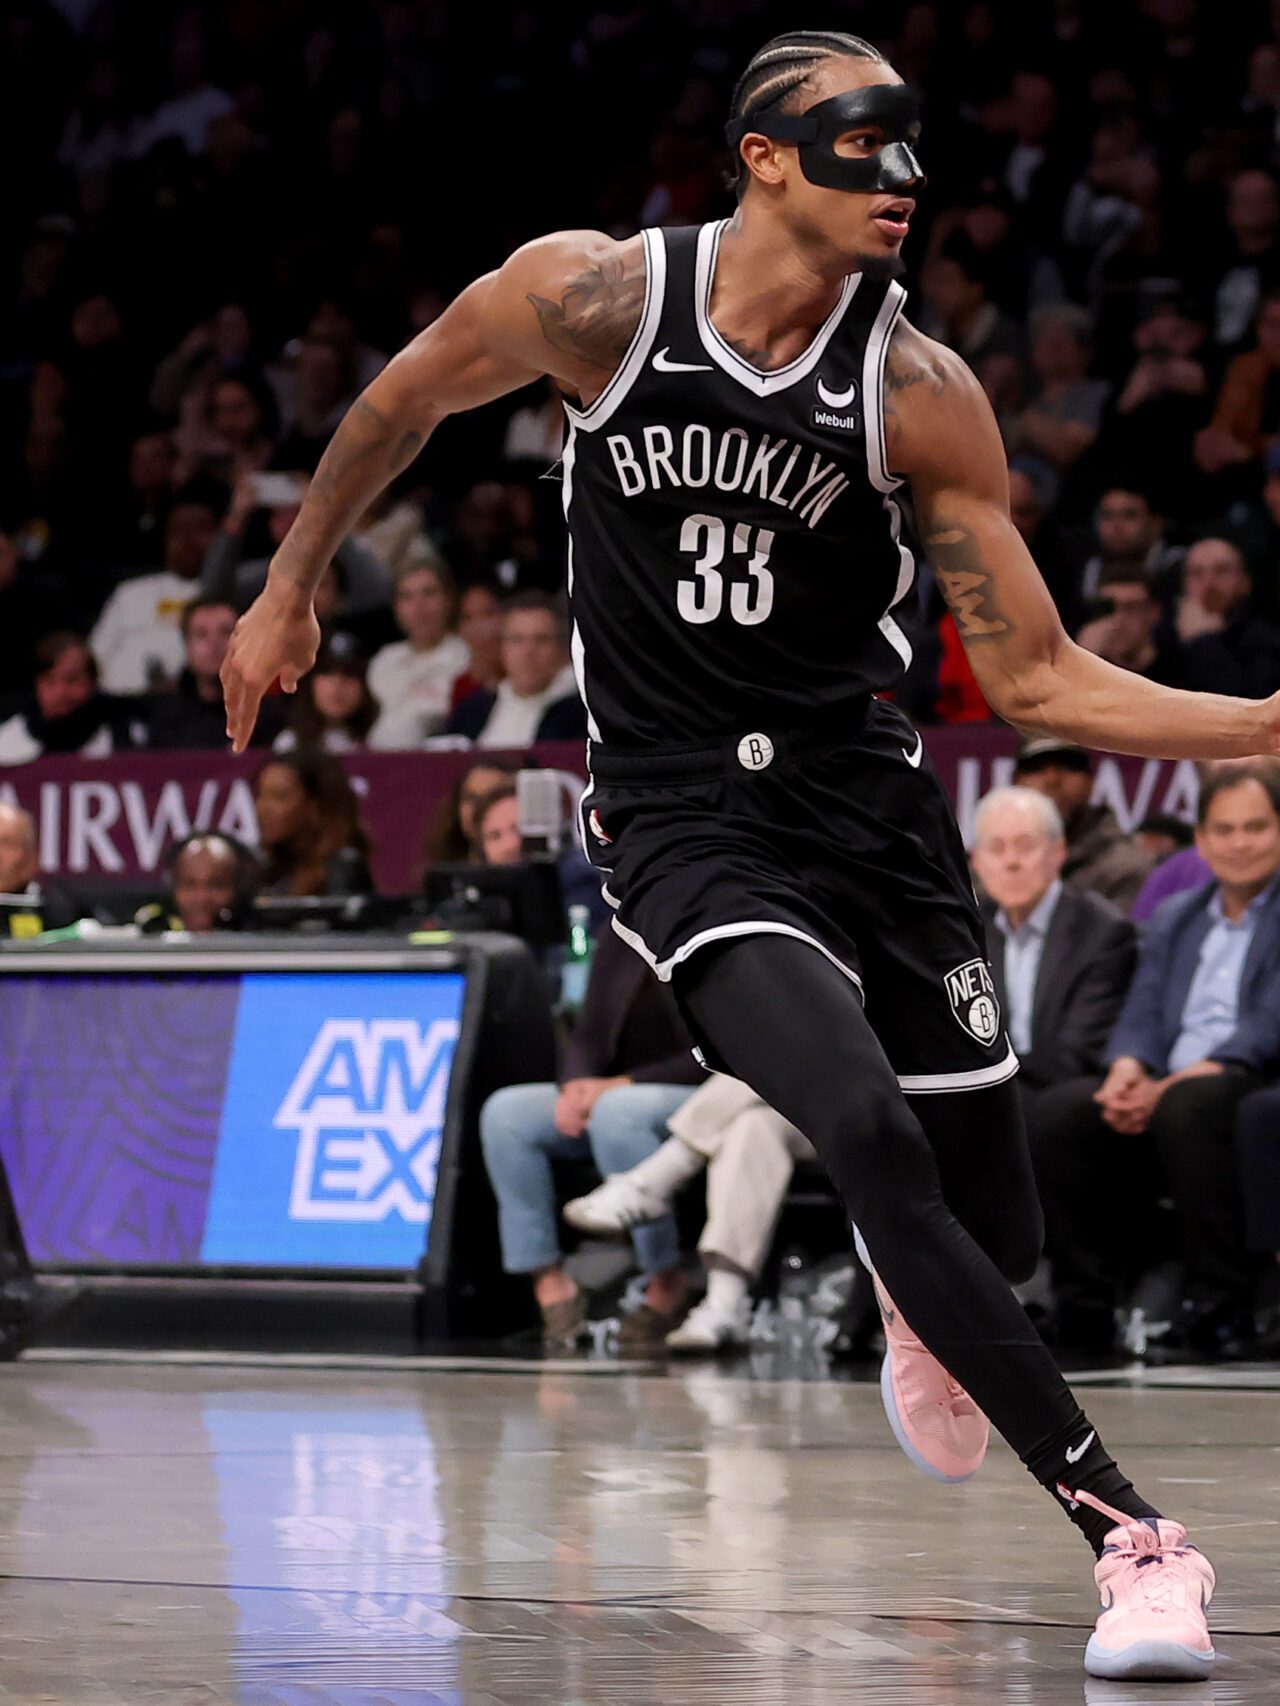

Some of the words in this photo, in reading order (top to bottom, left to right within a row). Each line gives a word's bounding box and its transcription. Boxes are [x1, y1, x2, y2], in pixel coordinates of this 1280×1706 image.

[815, 411, 854, 429] Webull
[606, 423, 849, 529] BROOKLYN
[677, 513, 776, 625] 33
[0, 779, 370, 873] IRWA
[289, 1126, 439, 1221] EX
